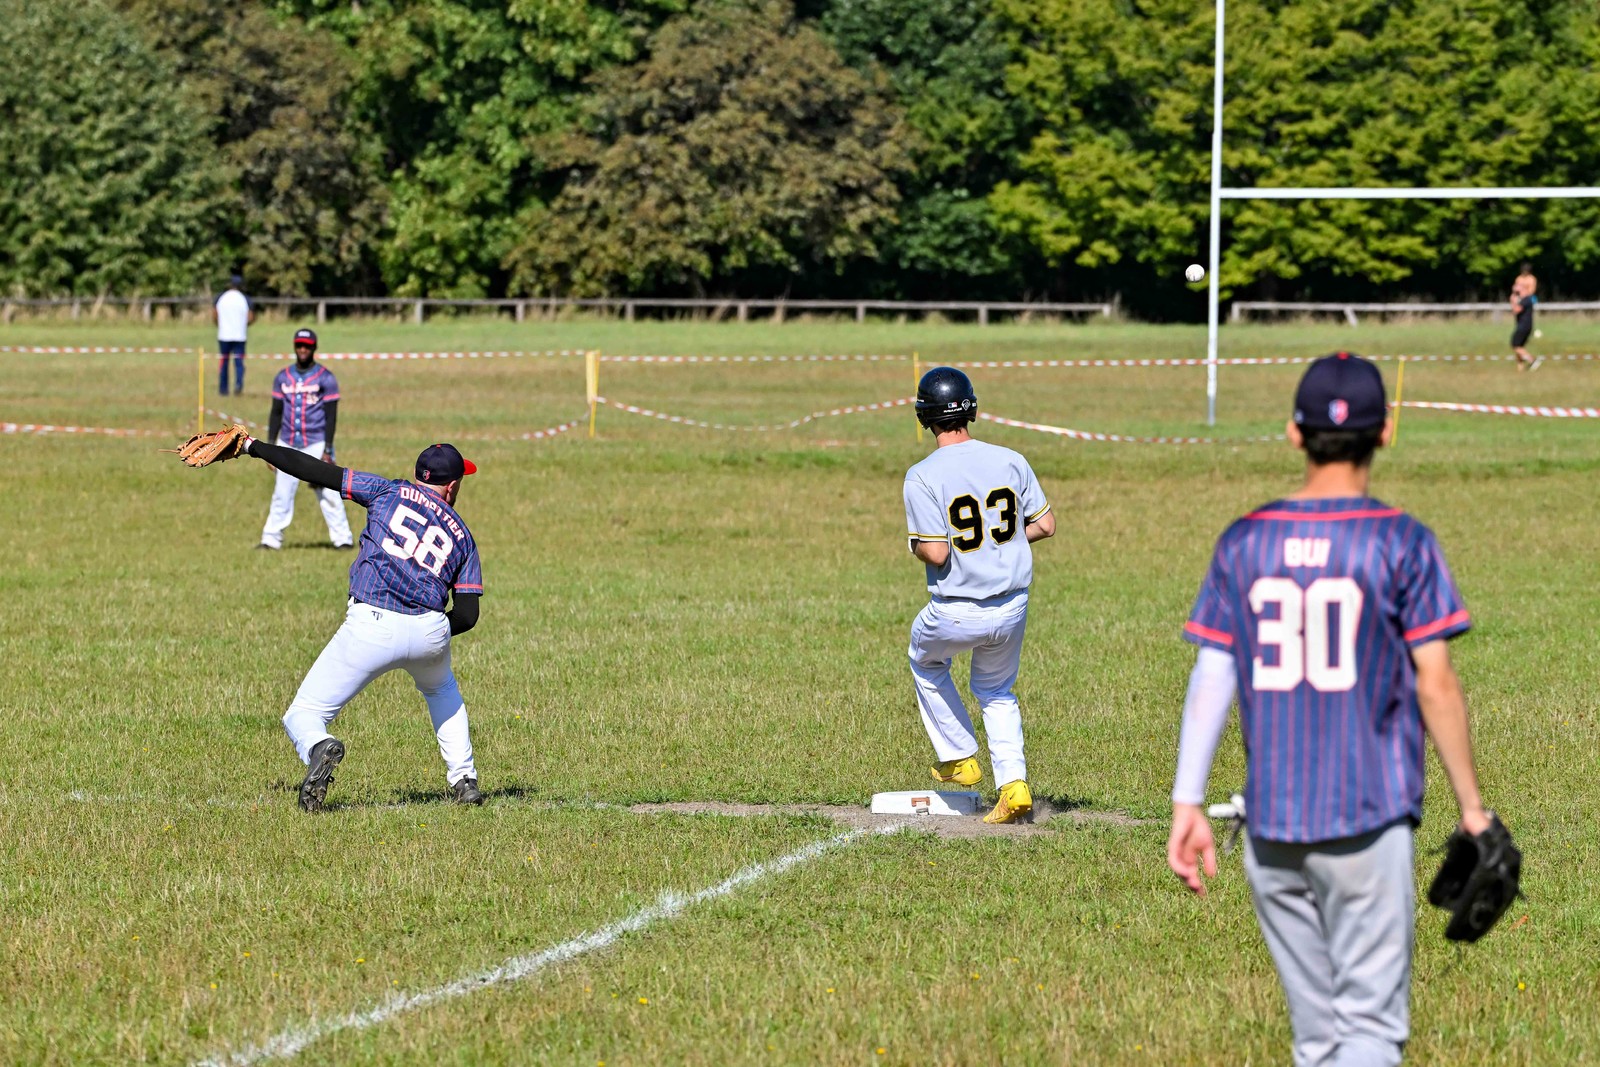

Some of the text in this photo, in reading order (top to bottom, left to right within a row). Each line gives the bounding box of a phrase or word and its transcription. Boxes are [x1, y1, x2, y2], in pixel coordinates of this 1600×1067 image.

[381, 503, 453, 577] 58
[947, 486, 1018, 553] 93
[1284, 537, 1332, 568] BUI
[1248, 576, 1364, 692] 30
